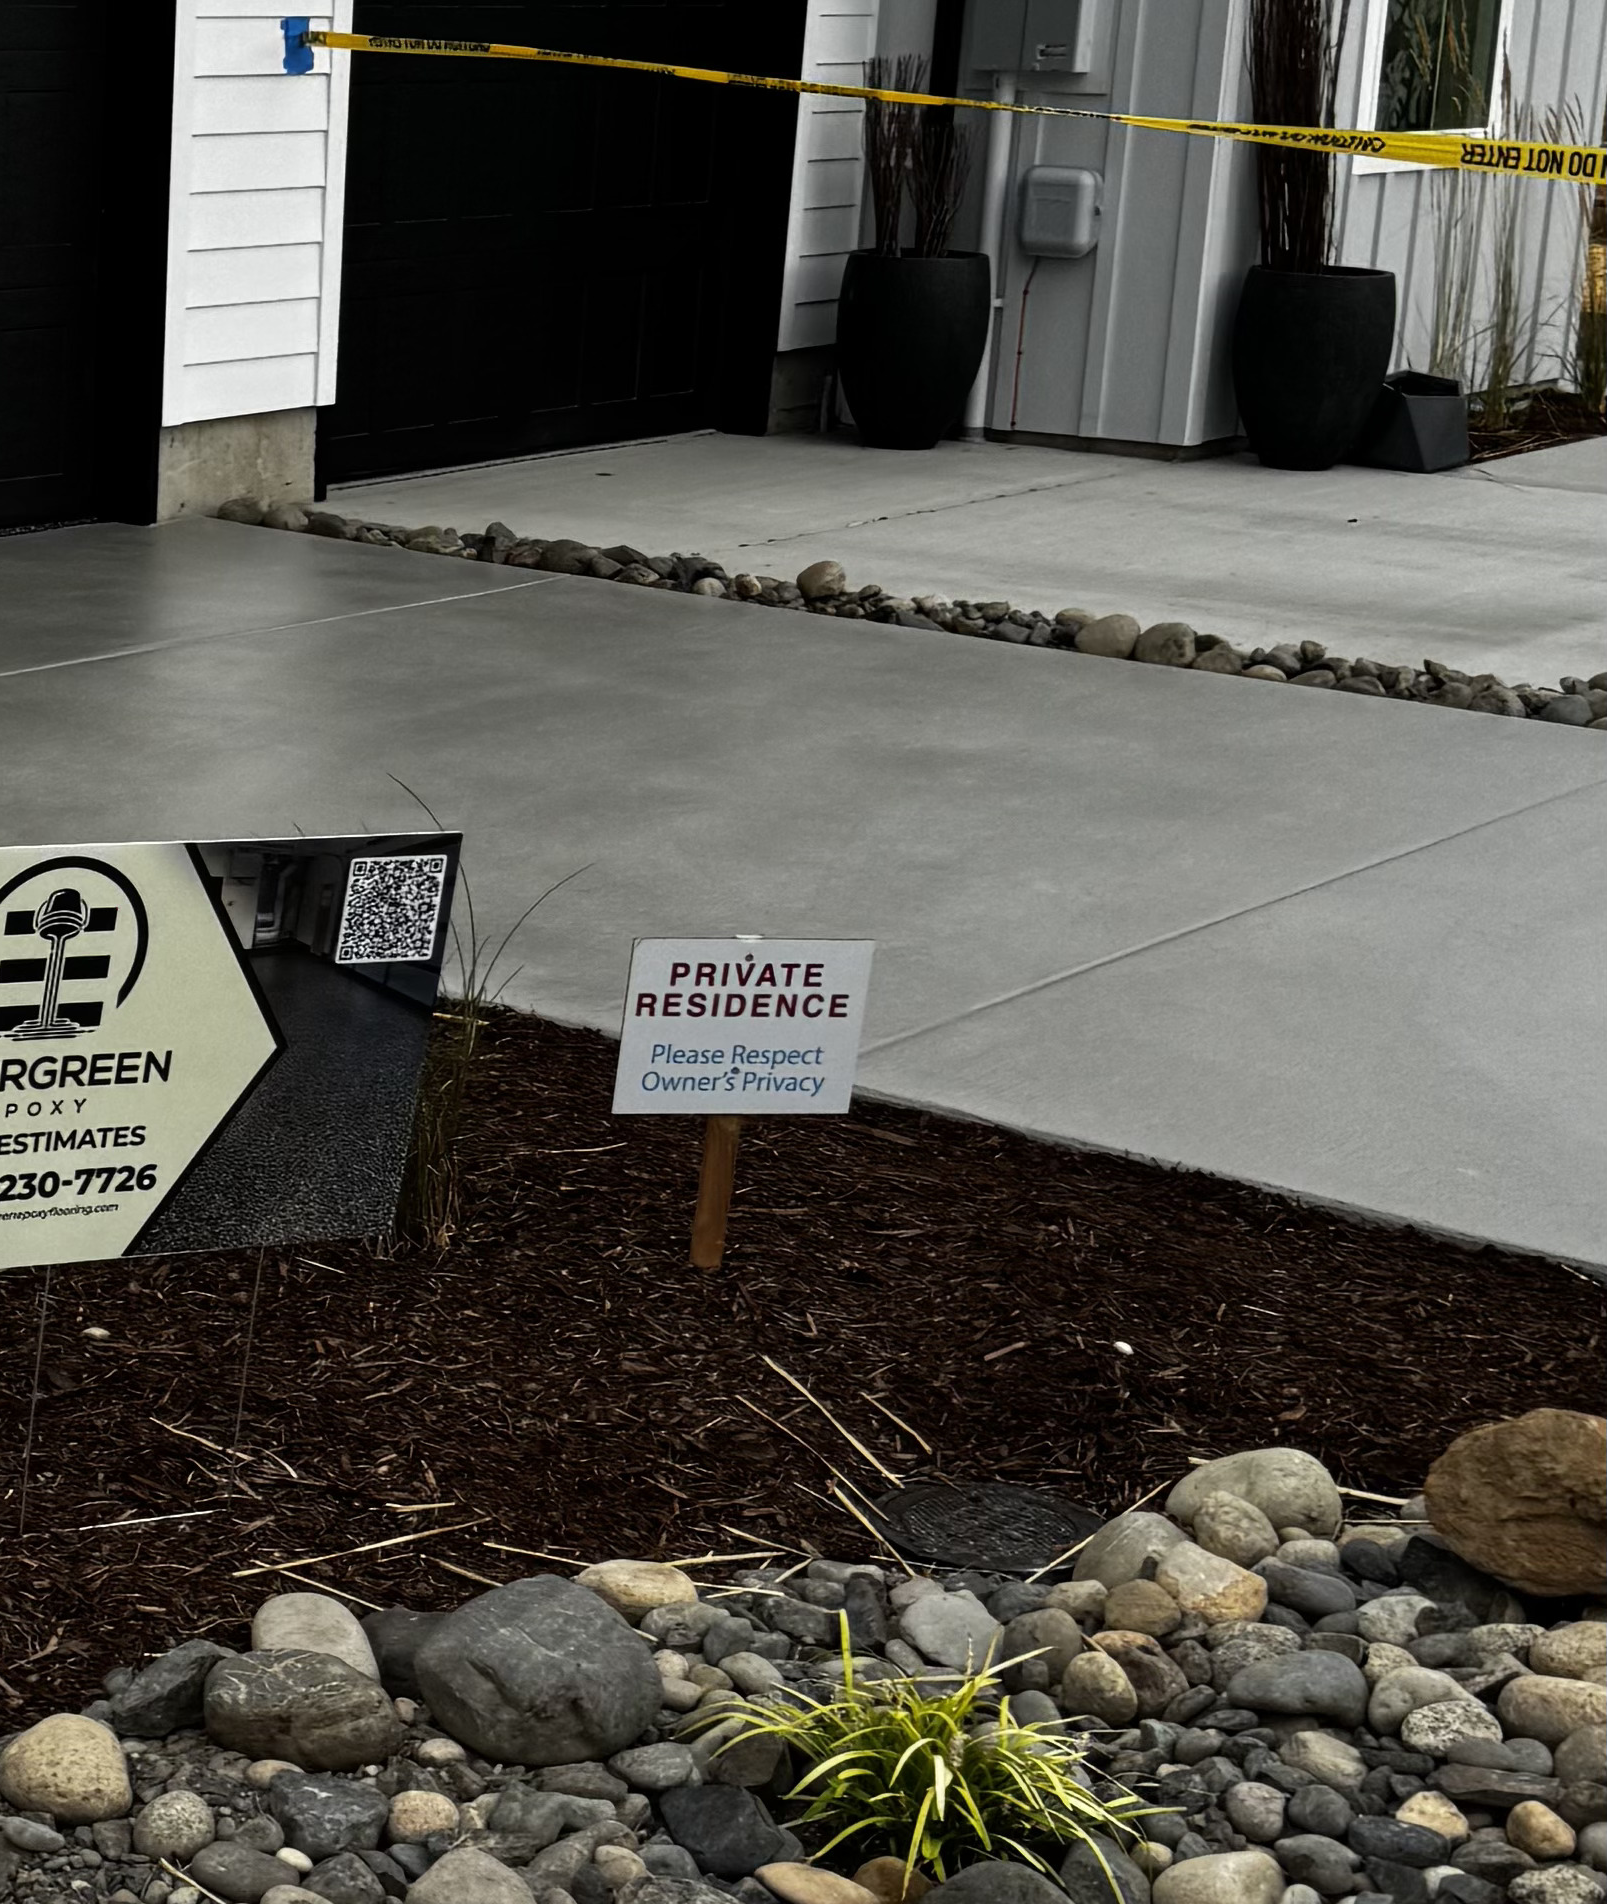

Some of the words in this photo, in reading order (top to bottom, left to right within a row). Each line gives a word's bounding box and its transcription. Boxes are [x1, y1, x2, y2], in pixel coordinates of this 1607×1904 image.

[1460, 143, 1521, 171] ENTER
[1522, 148, 1565, 175] NOT
[1568, 151, 1598, 178] DO
[669, 962, 825, 988] PRIVATE
[635, 992, 850, 1018] RESIDENCE
[651, 1044, 725, 1064] Please
[731, 1044, 825, 1069] Respect
[641, 1071, 737, 1092] Owner's
[742, 1072, 825, 1097] Privacy
